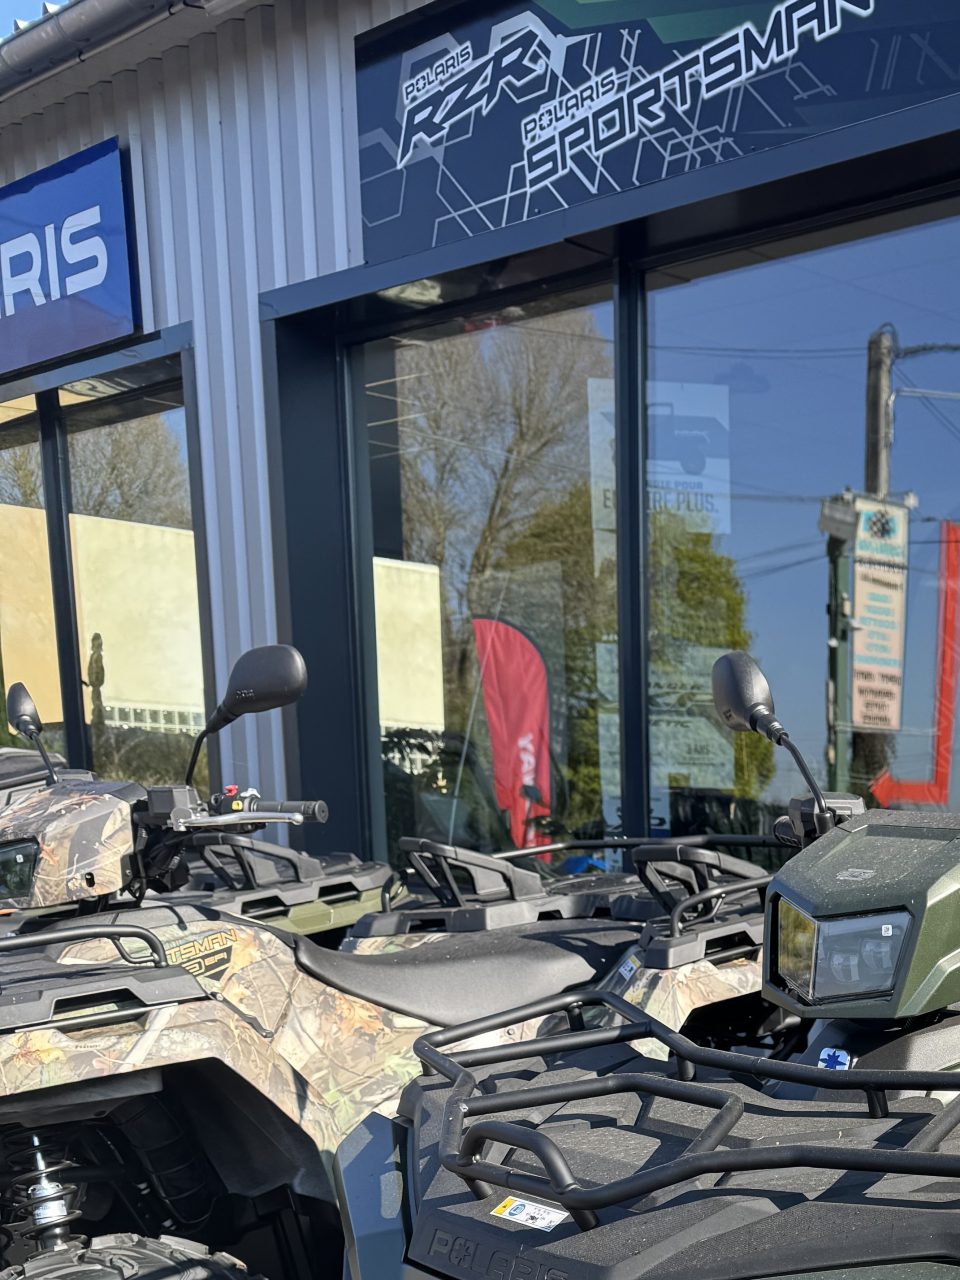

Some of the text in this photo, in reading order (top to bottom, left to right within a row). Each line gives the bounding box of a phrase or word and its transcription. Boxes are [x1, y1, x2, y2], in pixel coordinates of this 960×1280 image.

[397, 27, 545, 169] RZR
[403, 43, 473, 102] POLARIS
[522, 70, 617, 144] POLARIS
[0, 205, 108, 320] RIS
[166, 929, 238, 963] TSMAN
